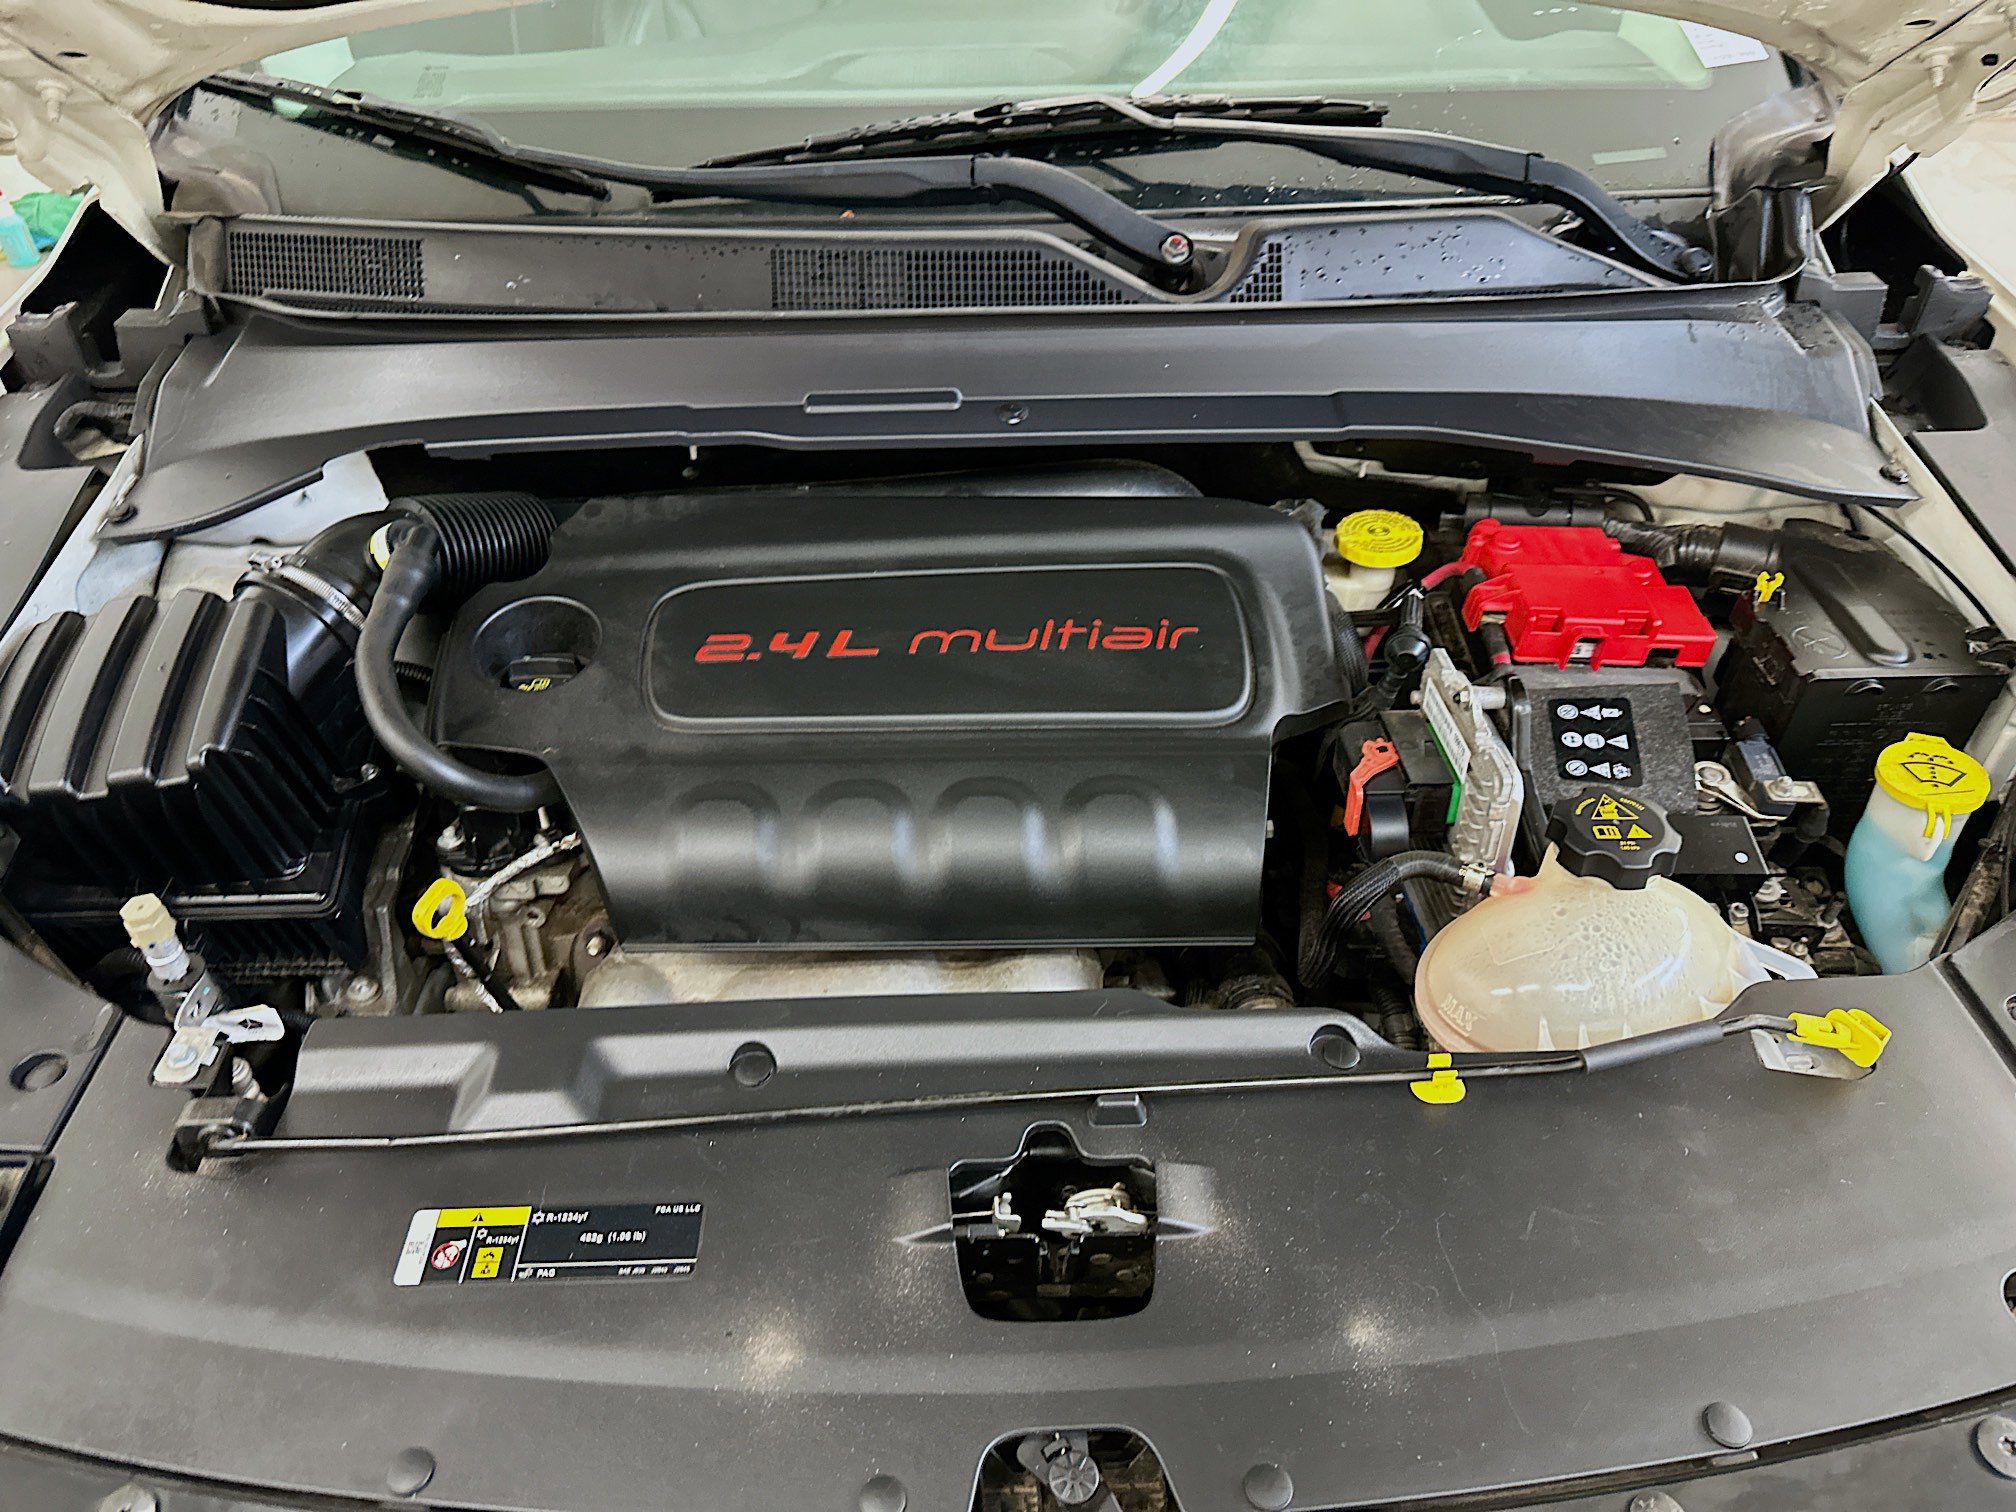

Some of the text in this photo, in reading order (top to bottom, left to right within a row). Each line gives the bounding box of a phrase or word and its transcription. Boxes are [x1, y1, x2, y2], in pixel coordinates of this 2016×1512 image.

[908, 618, 1198, 655] multiair
[1440, 993, 1478, 1029] MAX
[545, 1211, 589, 1224] R-1234yf
